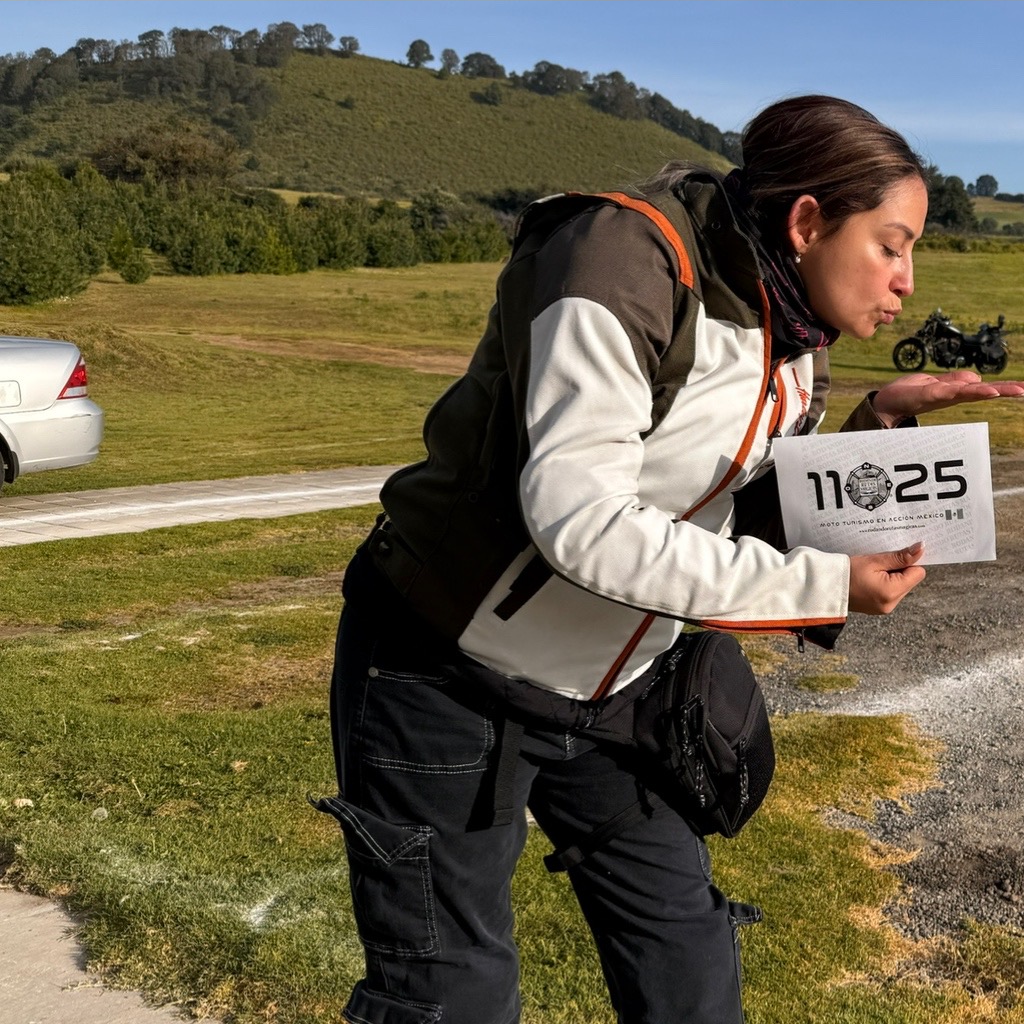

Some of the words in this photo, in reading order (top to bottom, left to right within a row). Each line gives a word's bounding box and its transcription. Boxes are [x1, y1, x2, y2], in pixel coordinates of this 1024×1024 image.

[806, 470, 844, 511] 11
[893, 459, 968, 503] 25
[842, 518, 875, 526] TURISMO
